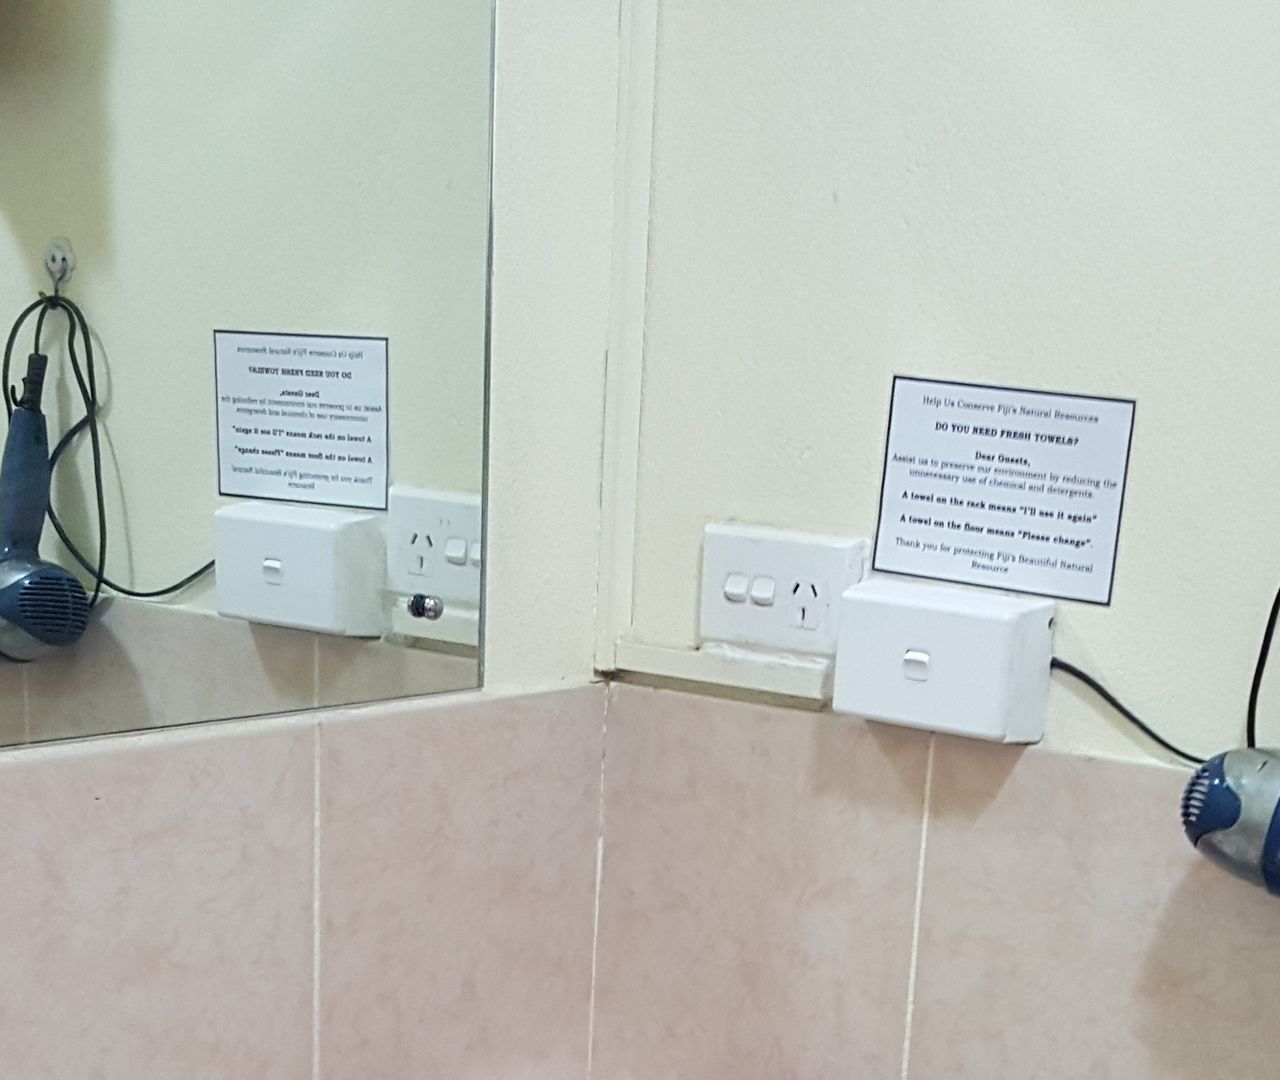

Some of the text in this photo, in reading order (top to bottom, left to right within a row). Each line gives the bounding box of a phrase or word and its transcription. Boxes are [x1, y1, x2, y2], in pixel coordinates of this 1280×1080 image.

[922, 394, 1099, 424] Help Us Conserve Fiji's Natural Resources
[934, 421, 1079, 446] DO YOU NEED FRESH TOWELS?
[891, 452, 1118, 489] Assist us to preserve our environment by reducing the
[974, 450, 1030, 467] Dear Guests,
[908, 468, 960, 483] unnecessary
[961, 475, 977, 484] use
[978, 476, 988, 485] of
[988, 477, 1026, 490] chemical
[1027, 483, 1045, 493] and
[901, 490, 908, 499] A
[910, 491, 934, 503] towel
[935, 496, 947, 504] on
[949, 496, 964, 506] the
[966, 500, 985, 509] rack
[988, 503, 1017, 513] means
[1038, 509, 1054, 518] use
[1057, 510, 1064, 520] it
[899, 513, 906, 523] A
[908, 515, 932, 526] towel
[933, 520, 944, 528] on
[947, 520, 961, 530] the
[963, 522, 984, 533] floor
[986, 527, 1015, 538] means
[895, 536, 1093, 573] Thank you for protecting Fiji's Beautiful Natural
[971, 559, 1009, 573] Resource
